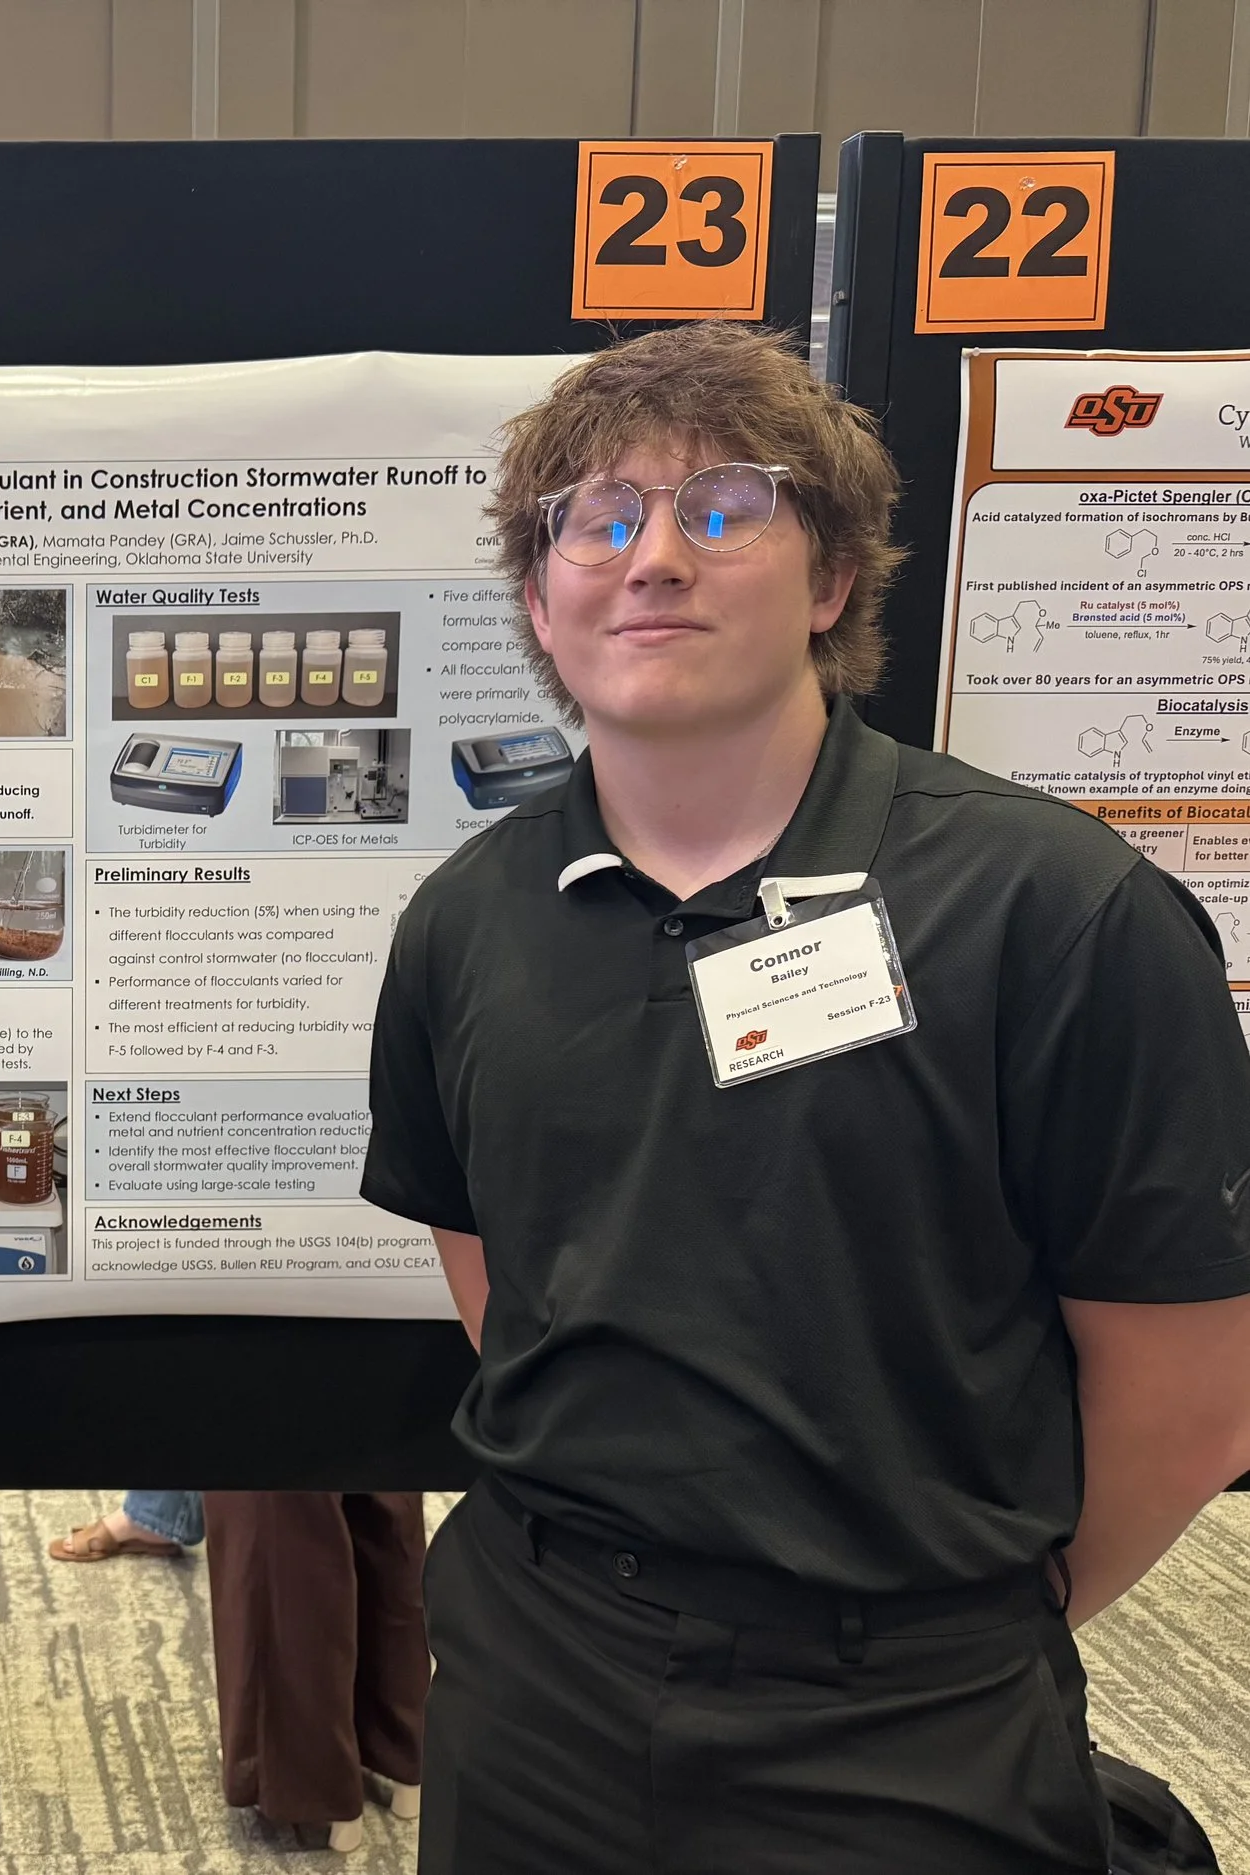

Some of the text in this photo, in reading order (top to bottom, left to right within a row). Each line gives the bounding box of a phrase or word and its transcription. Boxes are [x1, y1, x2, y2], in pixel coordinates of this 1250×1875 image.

[595, 175, 747, 267] 23
[939, 186, 1090, 278] 22
[1064, 384, 1165, 437] OSU
[63, 468, 83, 490] in
[91, 467, 238, 489] Construction
[245, 465, 379, 488] Stormwater
[386, 464, 459, 486] Runoff
[464, 464, 487, 485] to
[1079, 488, 1232, 504] oxa-Pictet Spengler
[60, 499, 106, 520] and
[113, 498, 180, 519] Metal
[187, 496, 367, 519] Concentrations
[971, 511, 1238, 524] Acid catalyzed formation of isochromans by
[42, 534, 105, 548] Mamata
[110, 533, 165, 549] Pandey
[170, 532, 216, 550] (GRA),
[221, 531, 265, 546] Jaime
[269, 531, 336, 545] Schussler,
[341, 530, 378, 544] Ph.D.
[475, 536, 502, 546] CIVIL
[1186, 532, 1231, 542] conc. HCl
[33, 551, 121, 569] Engineering,
[125, 551, 201, 566] Oklahoma
[205, 550, 243, 565] State
[247, 548, 314, 566] University
[96, 587, 260, 604] Water Quality Tests
[966, 673, 1246, 688] Took over 80 years for an asymmetric OPS
[1157, 697, 1249, 712] Biocatalysis
[439, 710, 544, 727] polyacrylamide.
[1174, 725, 1221, 739] Enzyme
[117, 823, 208, 835] Turbidimeter for
[138, 837, 187, 851] Turbidity
[292, 833, 399, 846] ICP-OES for Metals
[95, 865, 251, 882] Preliminary Results
[108, 904, 380, 920] The turbidity reduction (5%) when using the
[749, 939, 822, 972] Connor
[28, 967, 49, 977] N.D.
[770, 966, 809, 984] Bailey
[726, 969, 868, 1021] Physical Sciences and Technology
[827, 995, 891, 1021] Session F-23
[735, 1029, 768, 1052] OSU
[729, 1049, 784, 1073] RESEARCH
[93, 1086, 180, 1102] Next Steps
[8, 1134, 22, 1143] F-4
[94, 1213, 262, 1229] Acknowledgements
[91, 1235, 436, 1252] This project is funded through the USGS 104(b) program.
